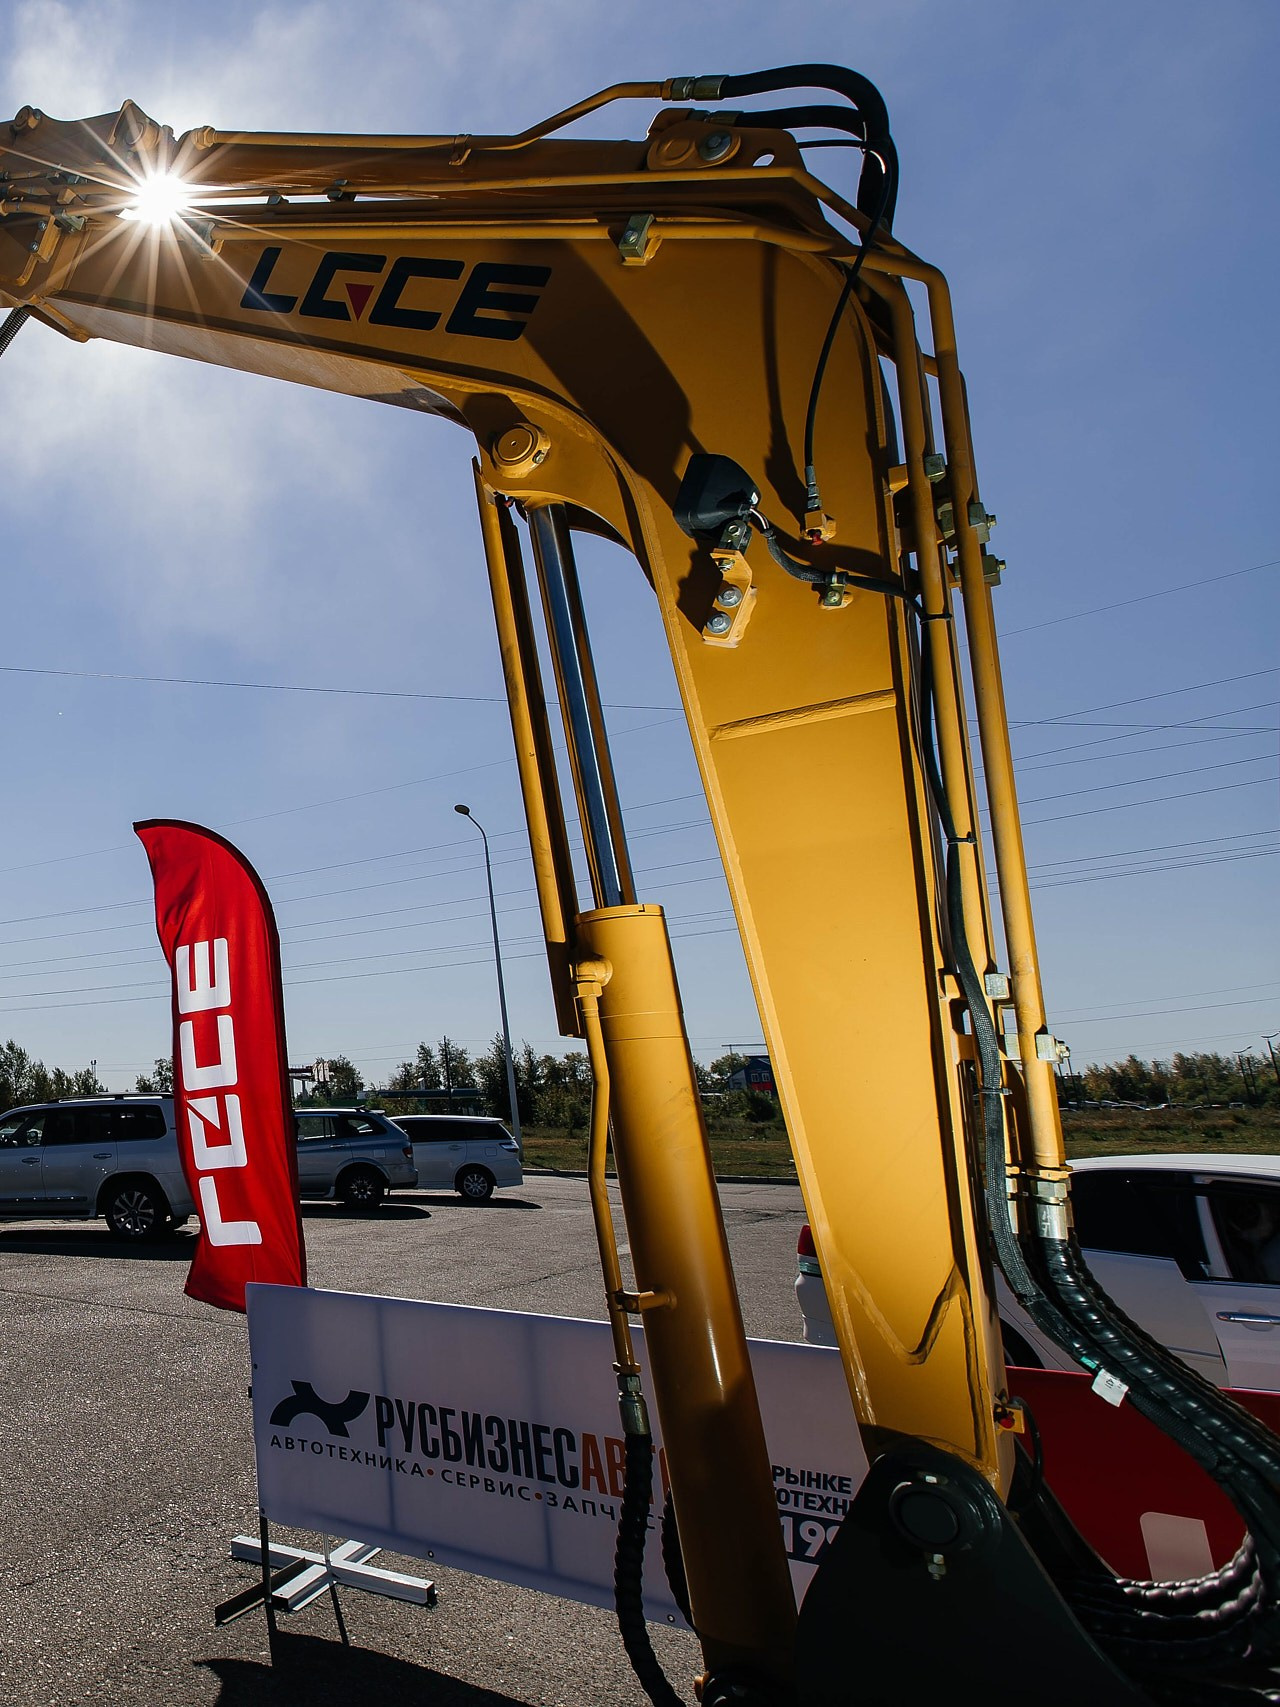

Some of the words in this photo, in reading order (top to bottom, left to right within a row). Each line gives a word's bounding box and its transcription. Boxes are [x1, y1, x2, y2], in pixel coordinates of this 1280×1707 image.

[240, 246, 552, 341] LGCE
[270, 1434, 424, 1479] АВТОТЕХНИКА
[441, 1468, 532, 1503] СЕРВИС
[374, 1395, 671, 1506] РУСБИЗНЕСАВ
[771, 1465, 853, 1495] РЫНКЕ
